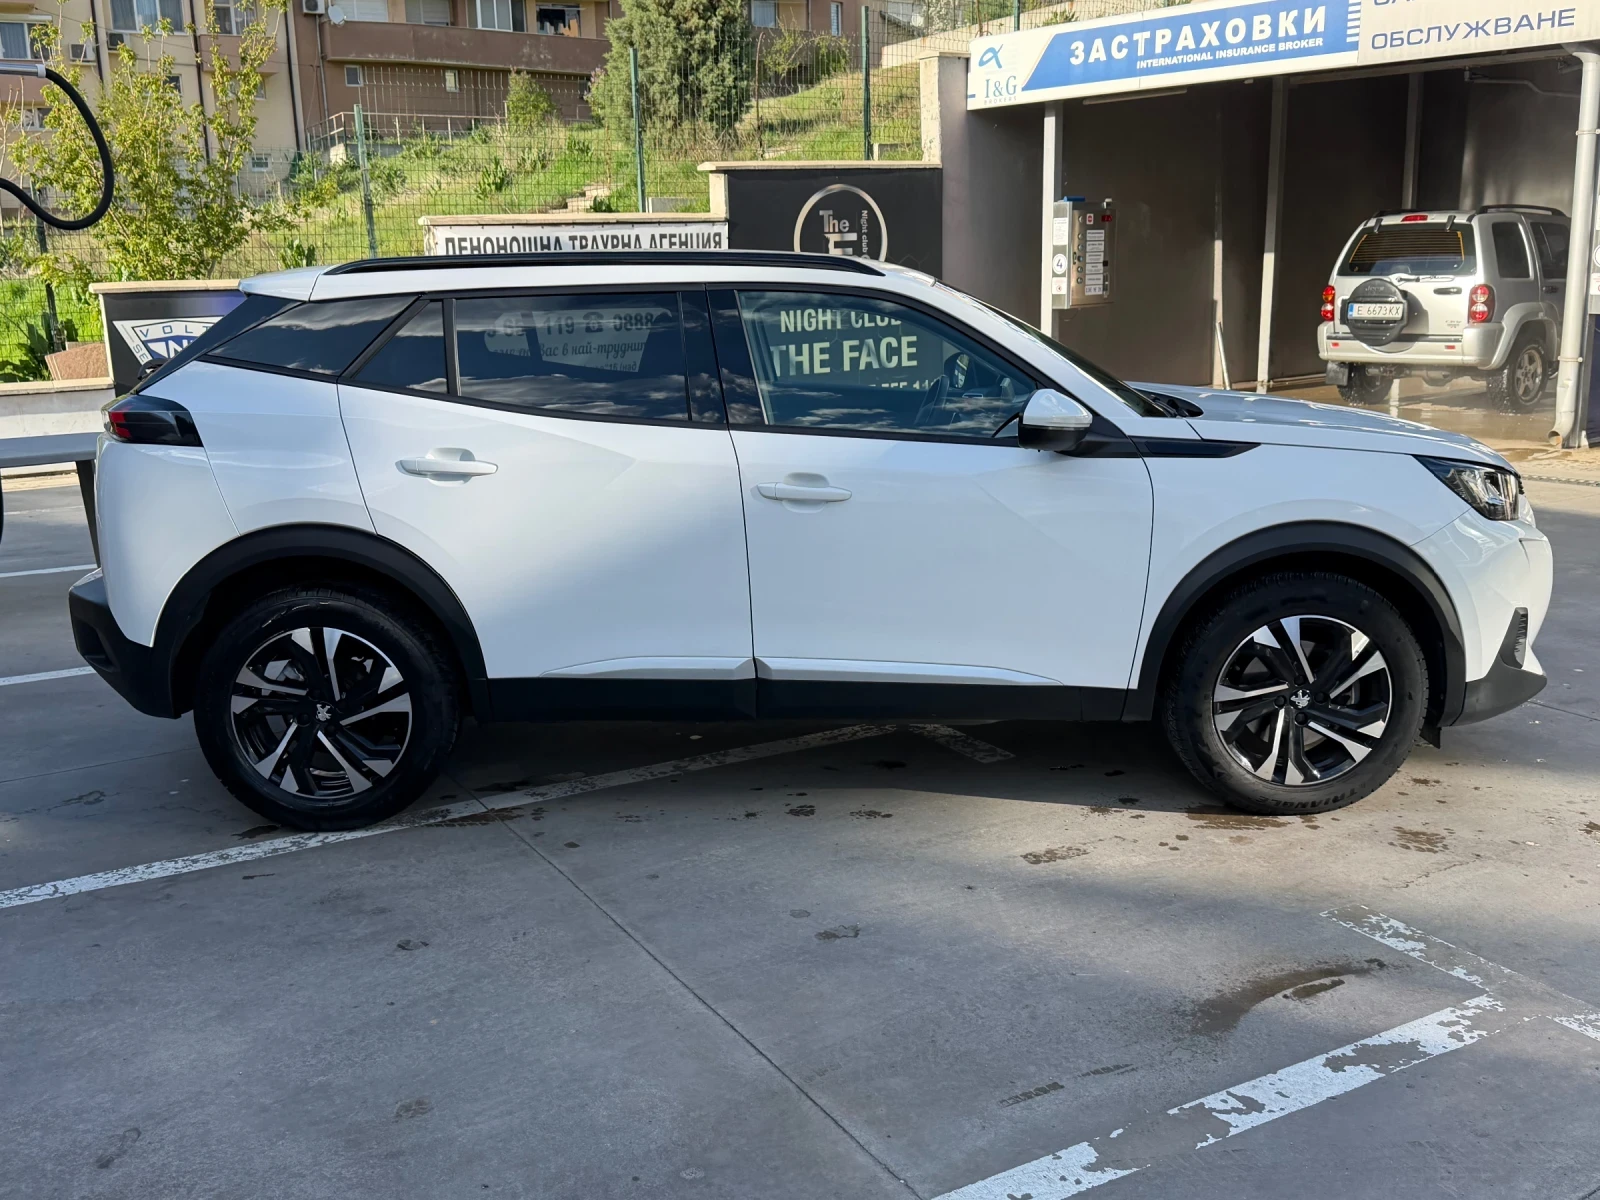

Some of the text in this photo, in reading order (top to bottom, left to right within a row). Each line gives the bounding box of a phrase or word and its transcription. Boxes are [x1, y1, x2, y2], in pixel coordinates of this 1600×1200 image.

[1069, 6, 1326, 65] ЗАСТРАХОВКИ
[1371, 8, 1576, 50] ОБСЛУЖВАНЕ
[1136, 37, 1324, 69] INTERNATIONAL INSURANCE BROKER
[819, 209, 850, 232] The
[1056, 258, 1063, 269] 4
[780, 308, 842, 332] NIGHT
[1357, 305, 1363, 315] E
[543, 315, 575, 336] 119
[770, 335, 918, 377] THE FACE
